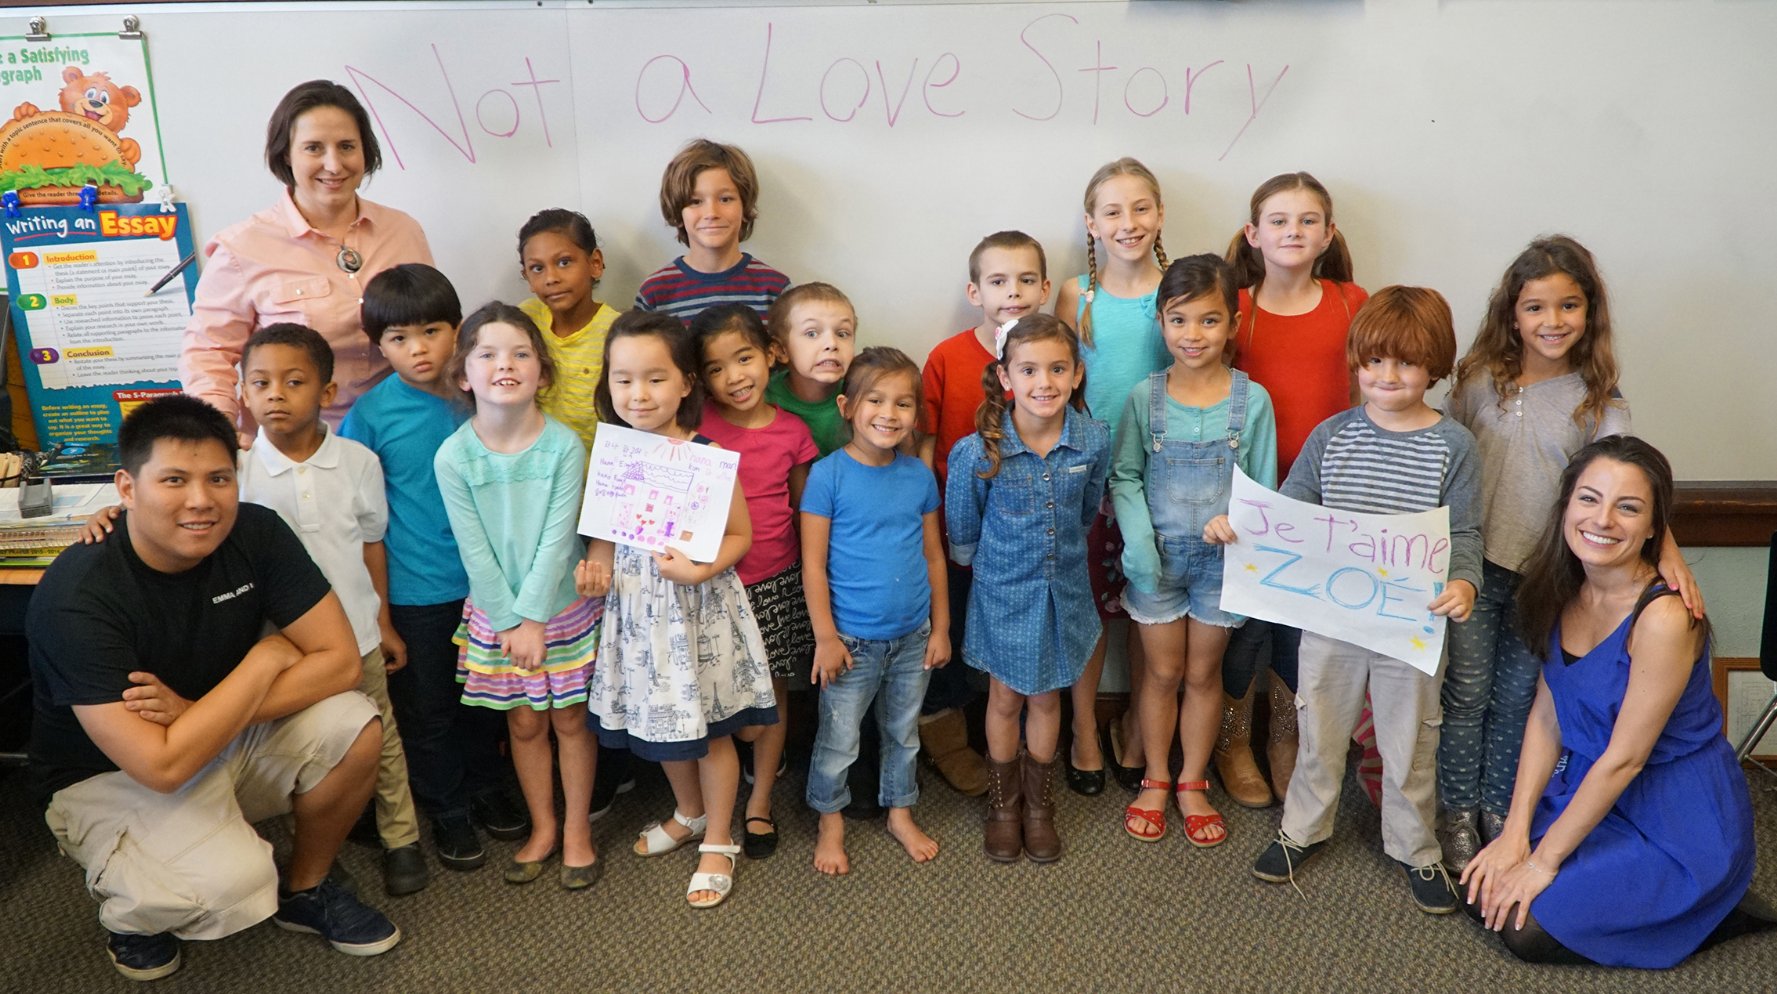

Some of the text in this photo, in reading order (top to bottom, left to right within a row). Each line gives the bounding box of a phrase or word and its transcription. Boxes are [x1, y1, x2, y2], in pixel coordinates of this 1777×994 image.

[8, 52, 17, 64] a
[20, 46, 90, 65] Satisfying
[345, 13, 1290, 170] Not a Love Story
[9, 127, 23, 139] topic
[22, 118, 48, 130] sentence
[62, 118, 82, 126] covers
[91, 127, 103, 135] you
[103, 134, 117, 147] want
[6, 211, 177, 240] Writing an Essay
[22, 254, 95, 266] 1 Introduction
[29, 296, 74, 307] 2 Body
[42, 349, 110, 361] 3 Conclusion
[1240, 498, 1304, 543] Je
[212, 592, 236, 604] EMMA
[236, 585, 250, 596] AND
